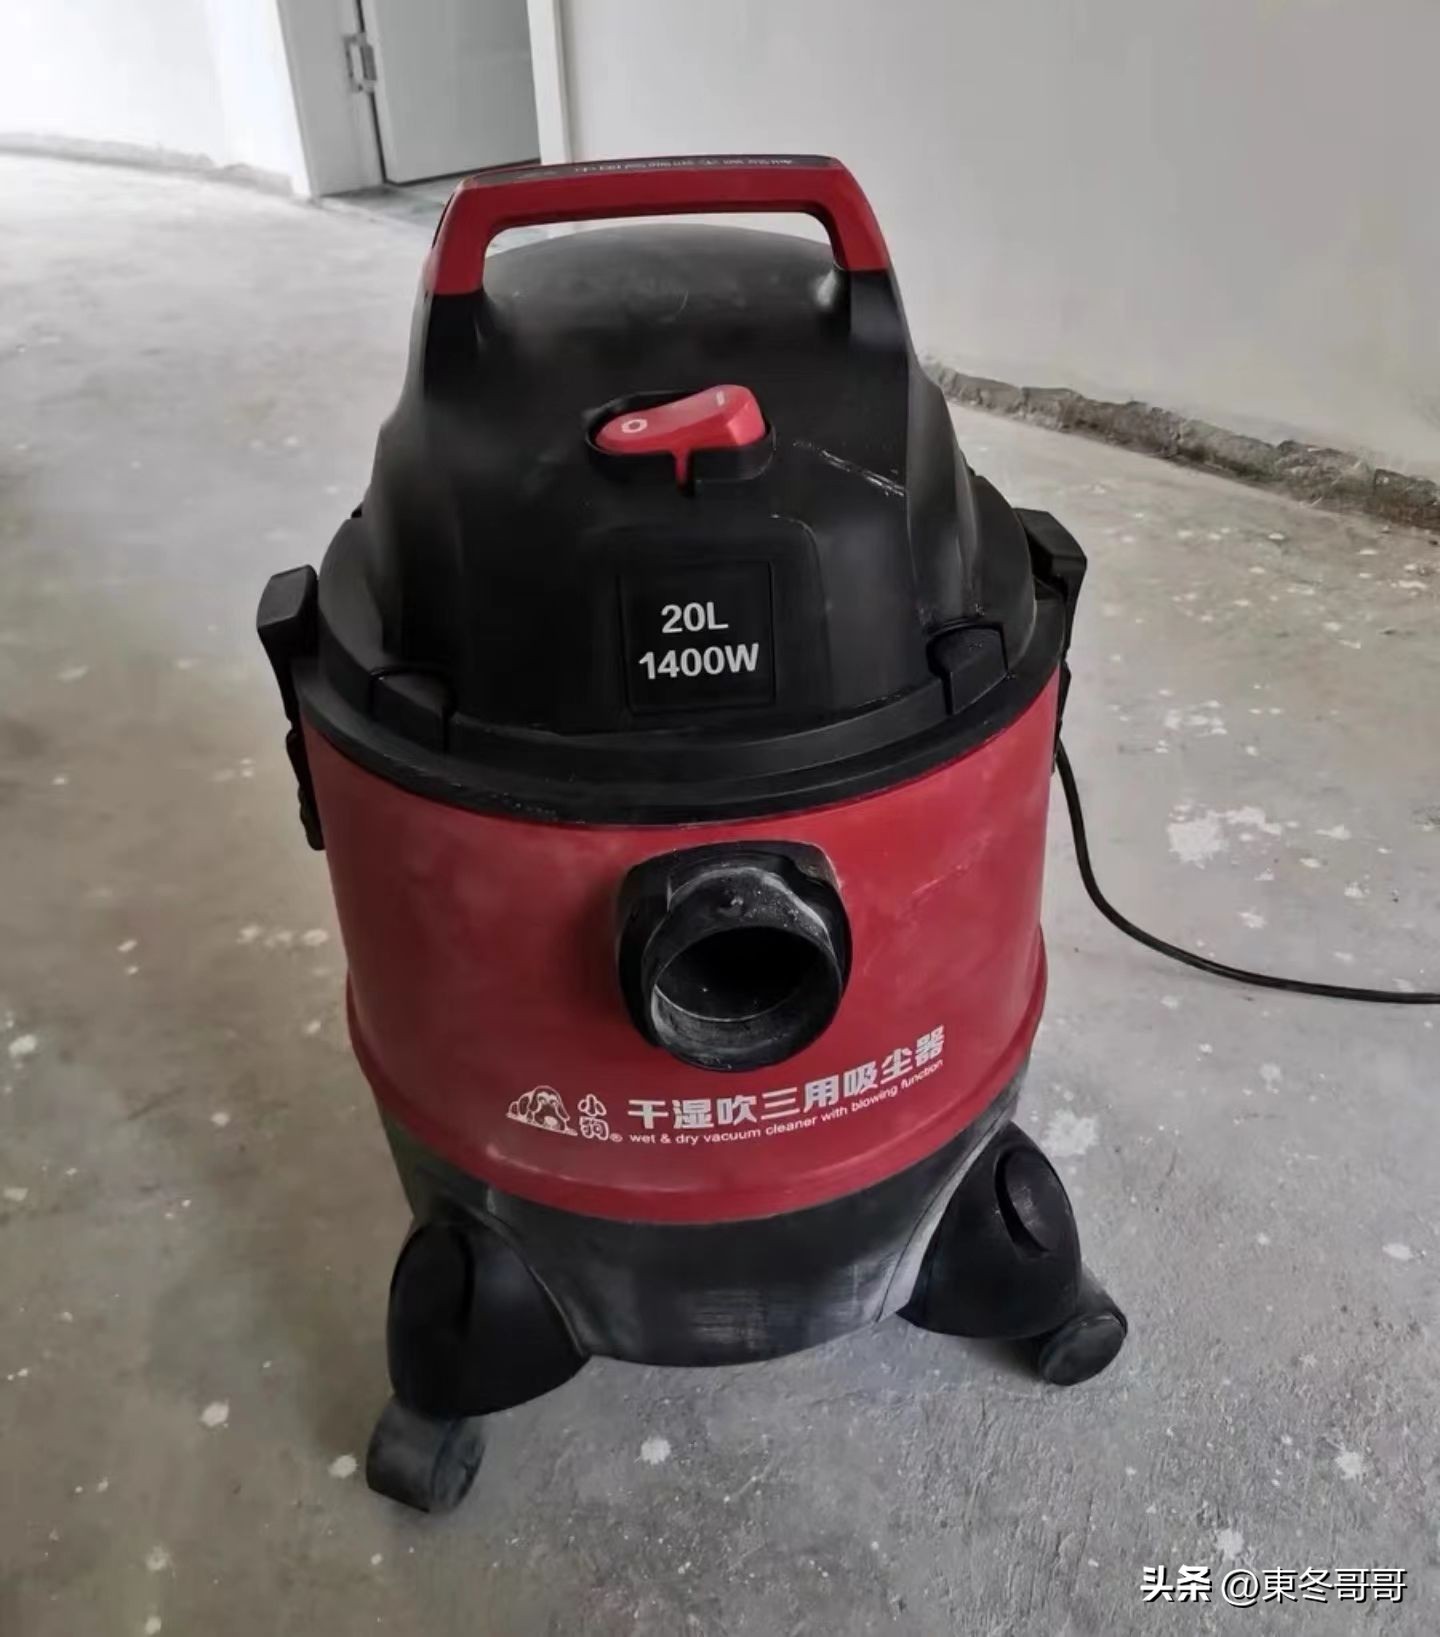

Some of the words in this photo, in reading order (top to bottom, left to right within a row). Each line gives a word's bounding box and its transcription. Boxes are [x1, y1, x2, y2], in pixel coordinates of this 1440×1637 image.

[661, 601, 729, 634] 20L
[638, 642, 760, 680] 1400W
[627, 1024, 945, 1130] 干湿吹三用吸尘器
[629, 1133, 656, 1144] wet
[660, 1133, 672, 1144] &
[675, 1132, 699, 1146] dry
[703, 1128, 762, 1144] vacuum
[765, 1116, 818, 1136] cleaner
[821, 1105, 849, 1122] with
[851, 1085, 898, 1112] blowing
[901, 1059, 944, 1089] function
